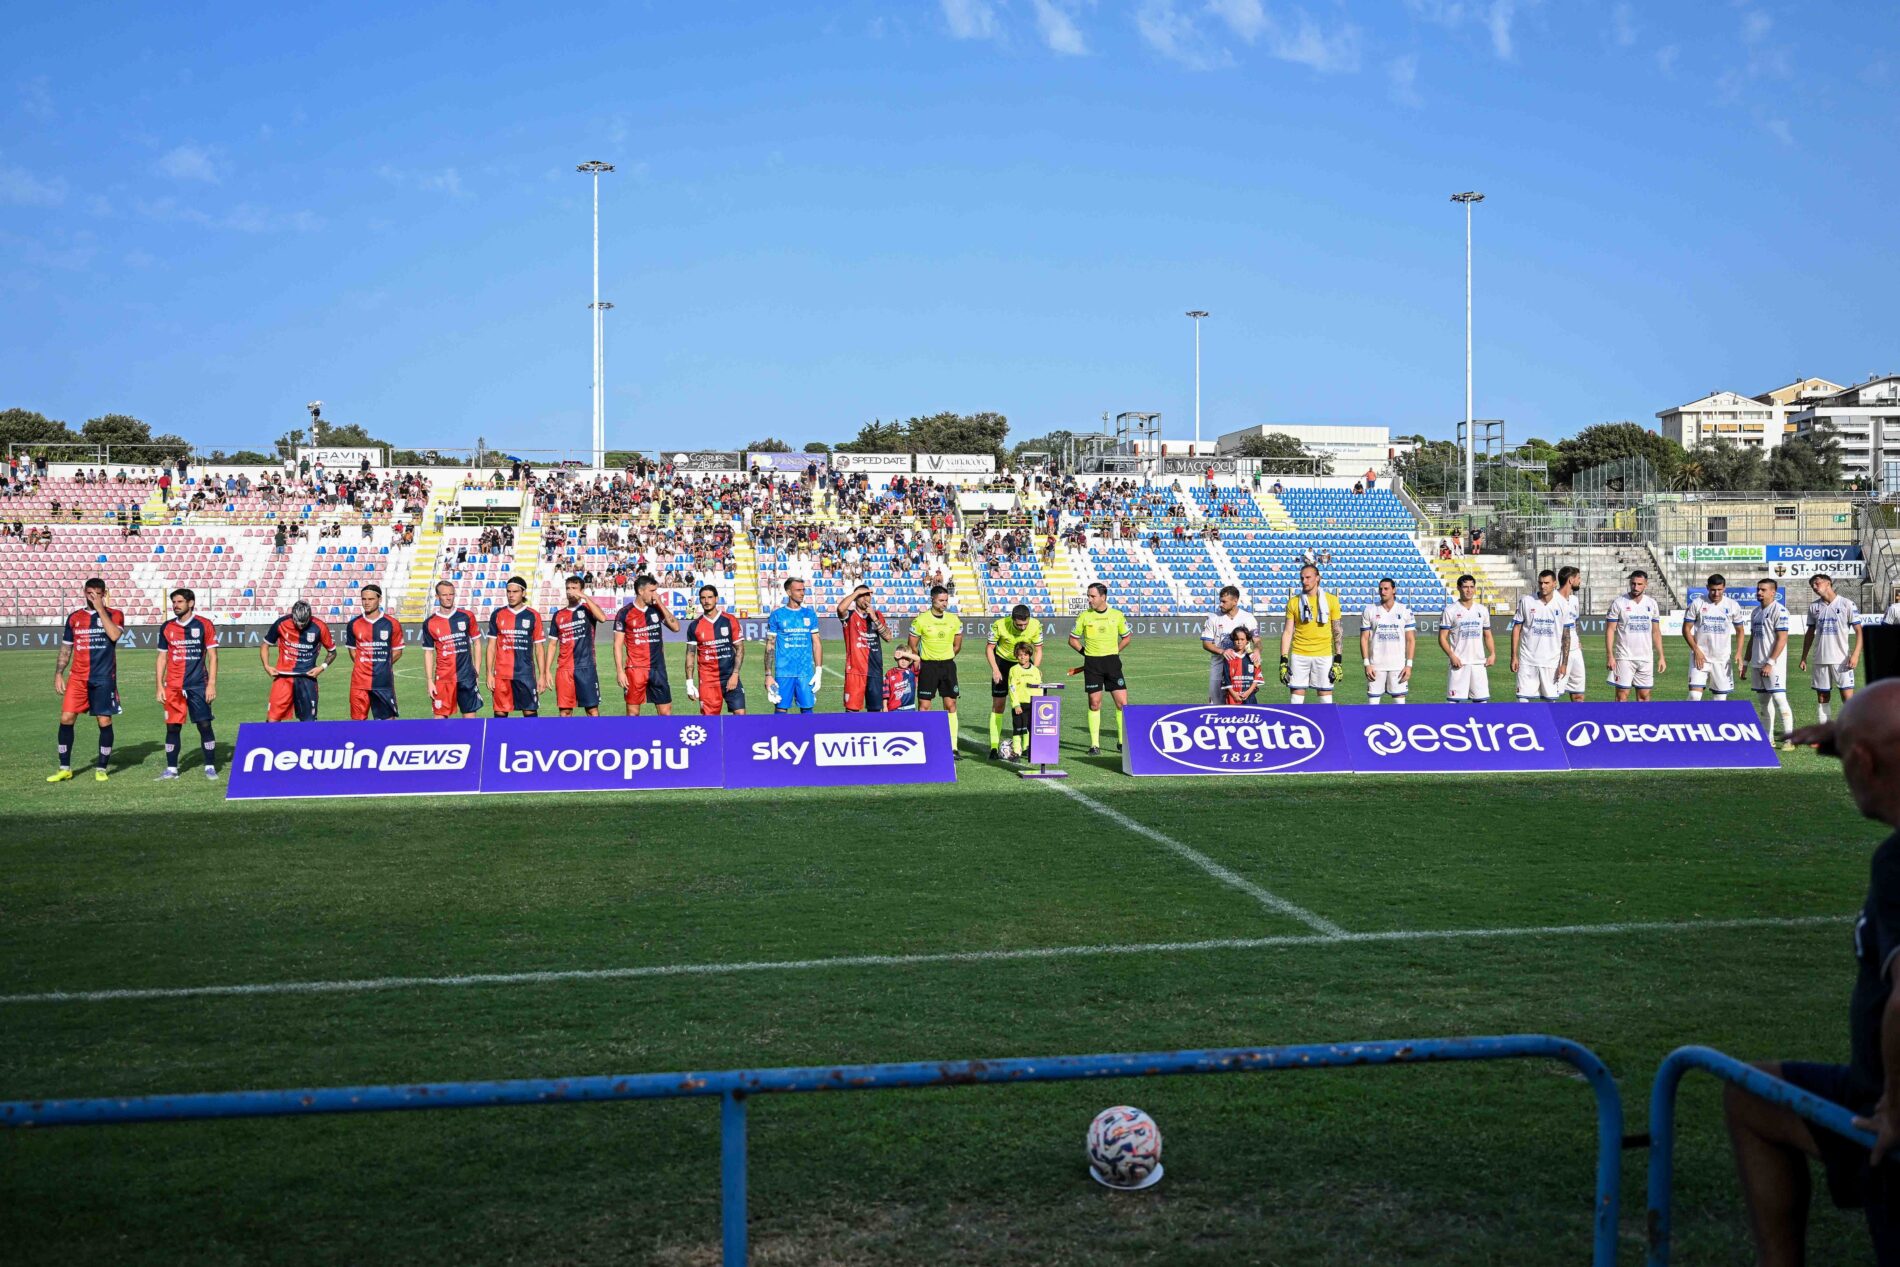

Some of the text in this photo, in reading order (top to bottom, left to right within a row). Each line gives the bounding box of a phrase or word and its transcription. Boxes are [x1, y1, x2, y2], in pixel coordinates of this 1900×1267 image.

[852, 456, 907, 465] SPEED DATE
[1812, 563, 1862, 576] JOSEPH
[1199, 713, 1263, 724] Fratelli
[1157, 720, 1316, 753] Beretta
[1407, 716, 1545, 752] estra
[1604, 723, 1762, 742] DECATHLON
[243, 742, 463, 772] netwin NEWS
[752, 736, 878, 765] sky wifi
[1219, 752, 1264, 763] 1812
